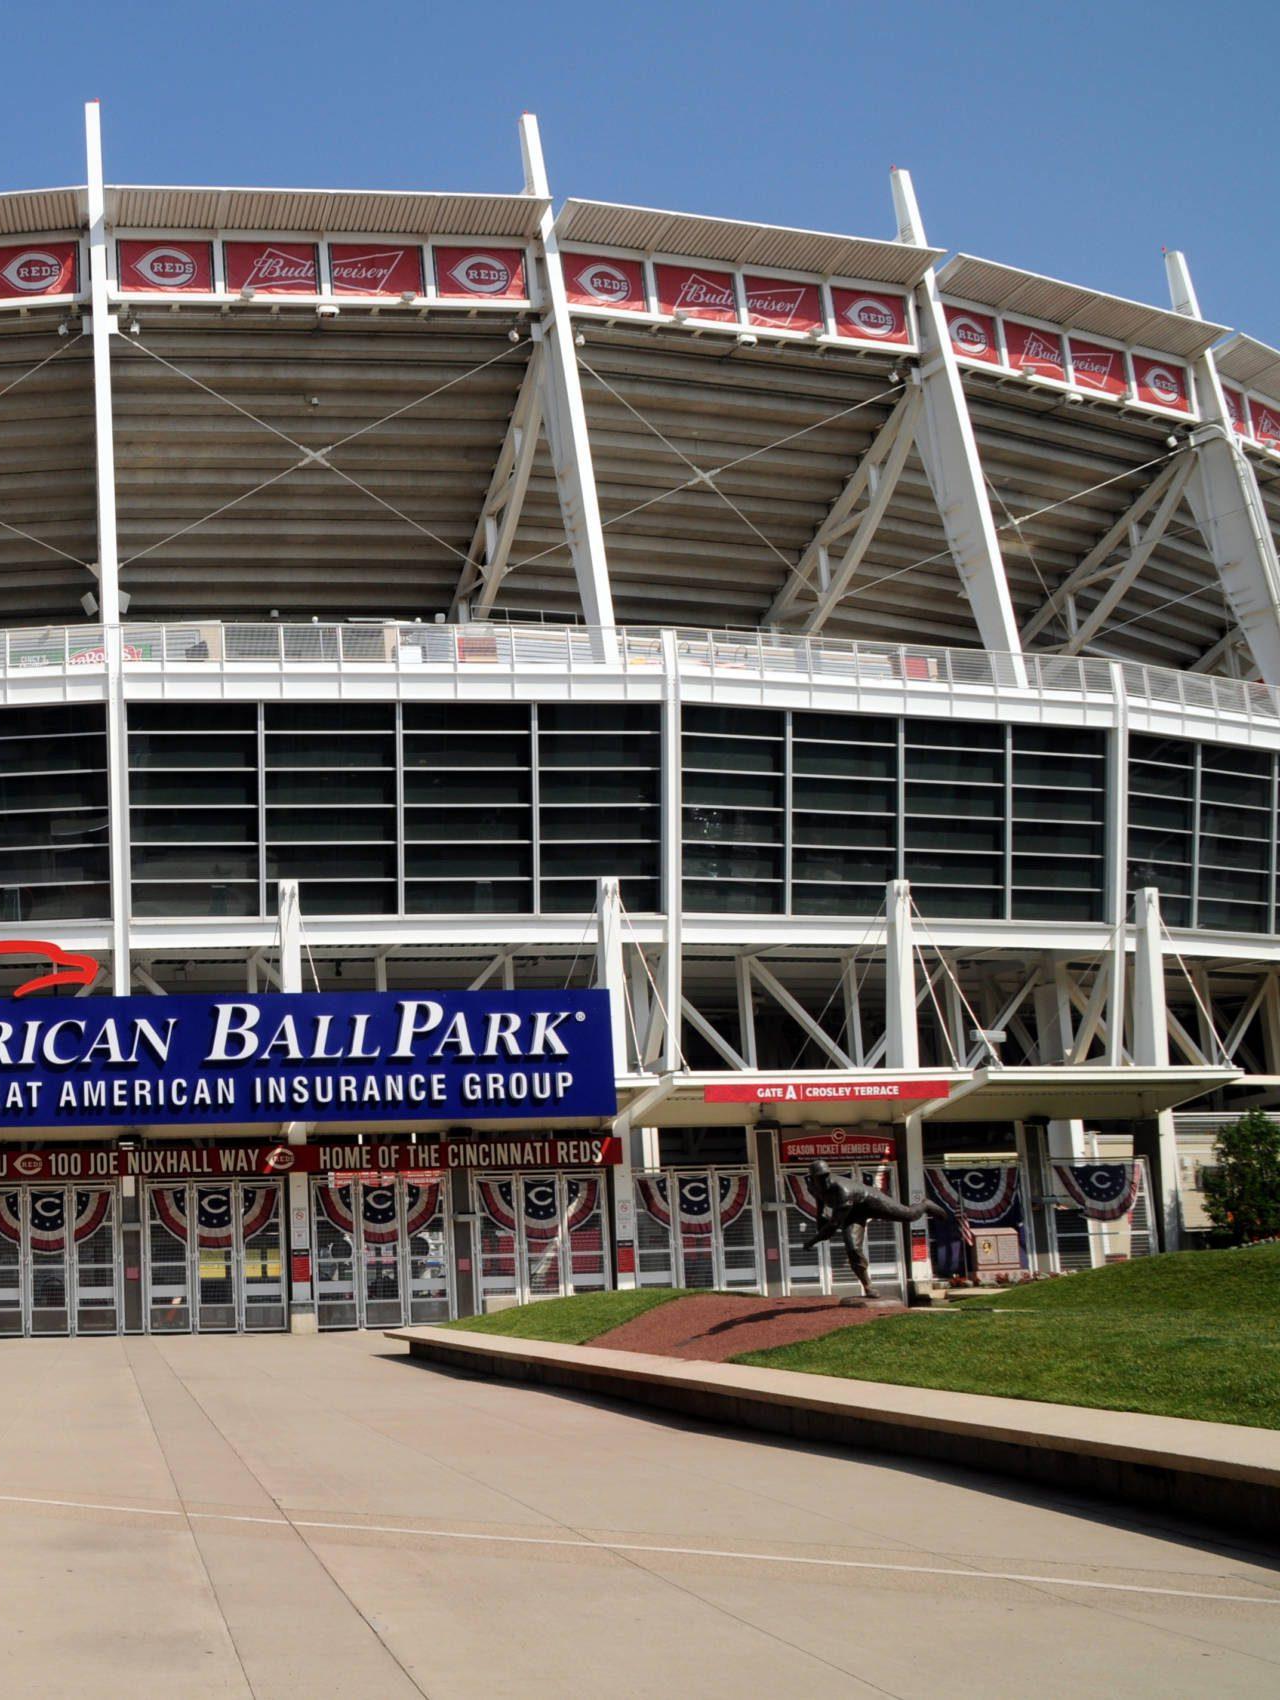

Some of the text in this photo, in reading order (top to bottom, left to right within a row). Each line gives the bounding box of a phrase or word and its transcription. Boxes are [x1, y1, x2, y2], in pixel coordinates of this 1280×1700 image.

[19, 265, 61, 278] REDS
[152, 261, 194, 274] REDS
[254, 257, 388, 279] Budweiser
[468, 268, 507, 282] REDS
[591, 277, 630, 292] REDS
[680, 283, 795, 313] Budweiser
[860, 310, 894, 326] REDS
[957, 329, 987, 345] REDS
[1024, 338, 1108, 375] Budweiser
[1154, 379, 1178, 393] REDS
[202, 1002, 382, 1062] BALL
[59, 1078, 235, 1107] AMERICAN
[255, 1074, 447, 1104] INSURANCE
[463, 1071, 573, 1100] GROUP
[757, 1085, 900, 1100] GATE A CROSLEY TERRACE
[787, 1143, 890, 1155] SEASON TICKET MEMBER GATE
[48, 1153, 82, 1176] 100
[88, 1152, 119, 1175] JOE
[127, 1150, 213, 1174] NUXHALL
[220, 1149, 260, 1173] WAY
[320, 1146, 371, 1170] HOME
[378, 1145, 400, 1169] OF
[407, 1143, 440, 1167] THE
[447, 1141, 551, 1166] CINCINNATI
[557, 1140, 602, 1163] REDS
